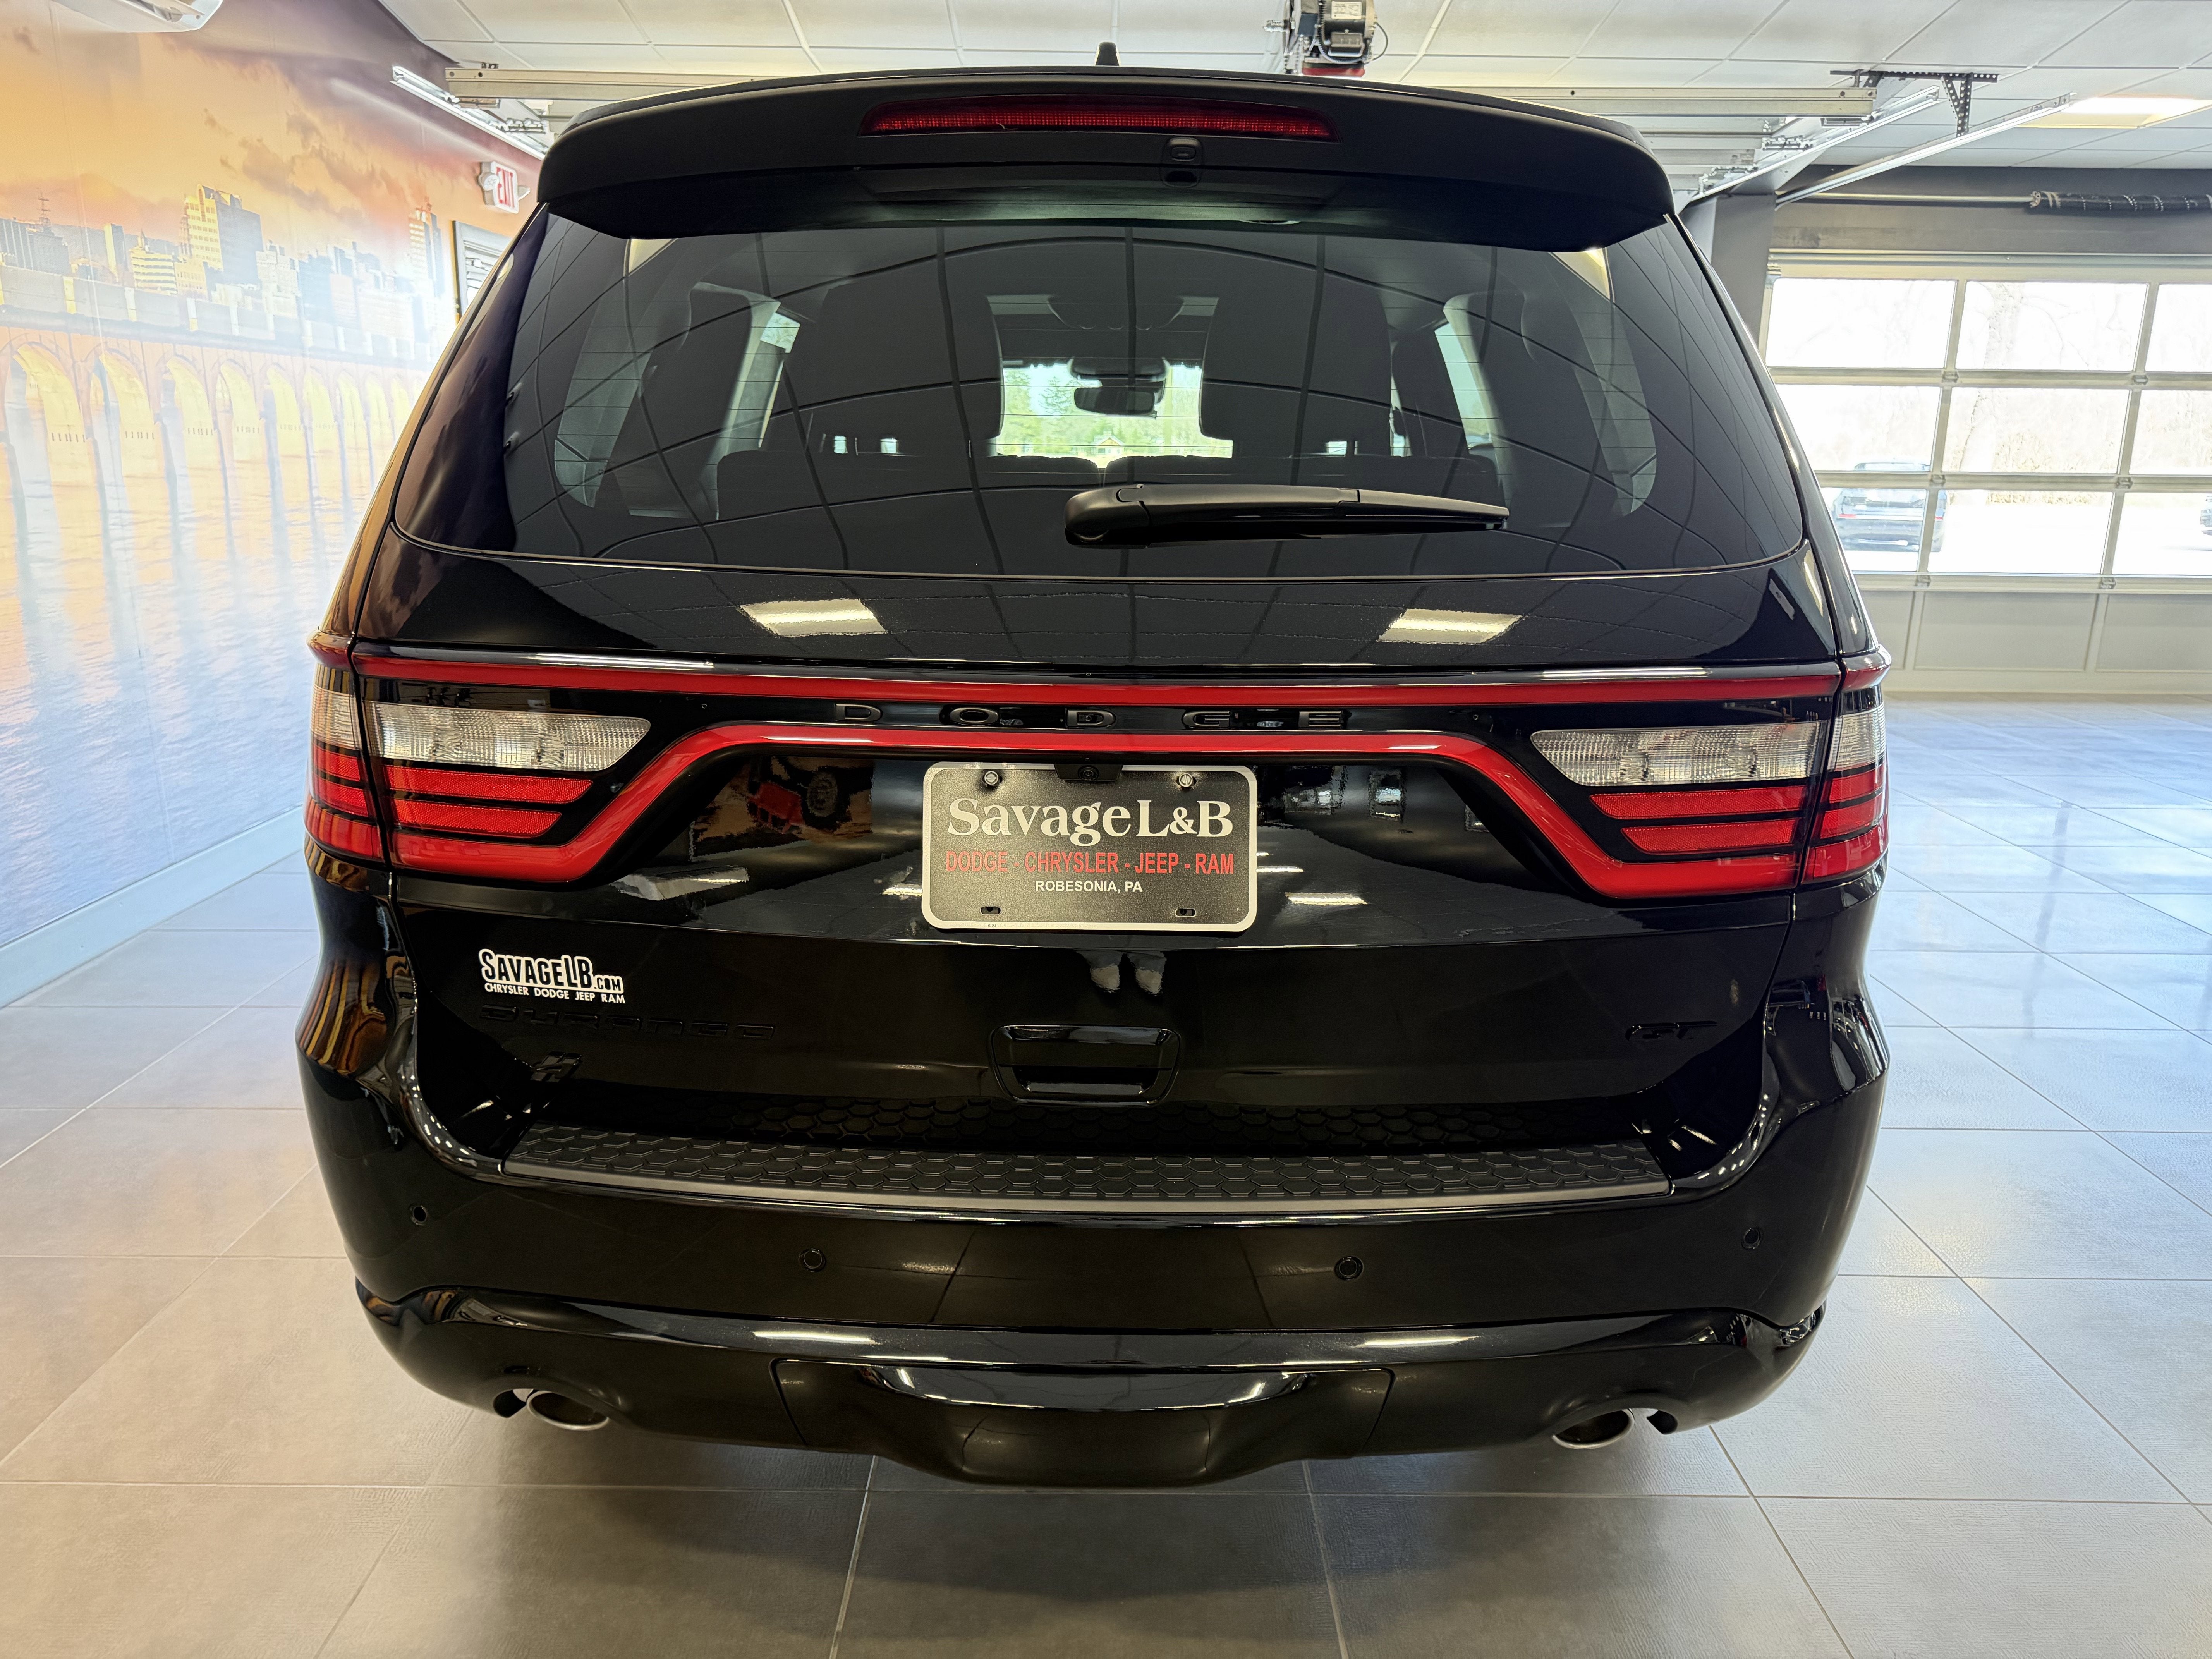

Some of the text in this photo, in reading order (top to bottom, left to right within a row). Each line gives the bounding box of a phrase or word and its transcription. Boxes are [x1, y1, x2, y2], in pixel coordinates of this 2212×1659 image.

[835, 703, 1344, 728] DODGE
[946, 850, 1008, 872] DODGE
[1024, 851, 1119, 874] CHRYSLER
[1134, 852, 1179, 874] JEEP
[1195, 852, 1234, 874] RAM
[1036, 880, 1143, 894] ROBESONIA, PA
[484, 982, 626, 1004] CHRYSLER DODGE JEEP RAM
